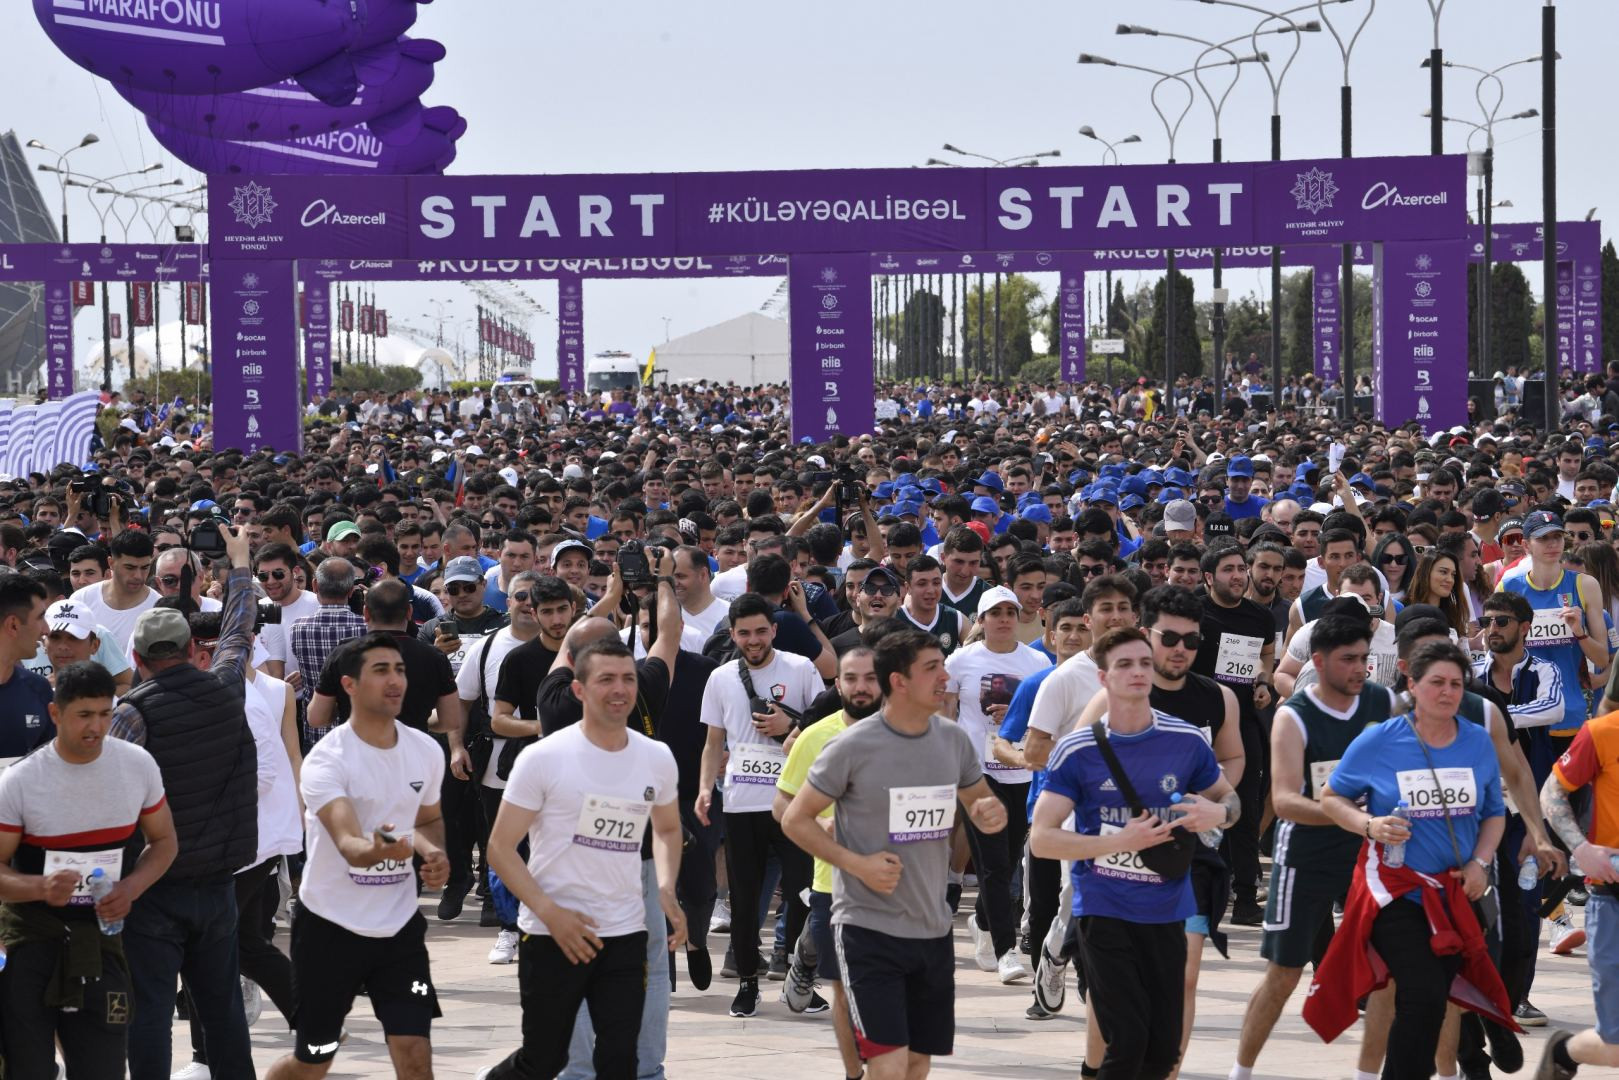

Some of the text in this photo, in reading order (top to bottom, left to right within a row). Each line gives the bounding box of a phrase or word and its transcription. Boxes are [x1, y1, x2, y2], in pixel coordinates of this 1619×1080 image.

[998, 183, 1243, 230] START
[1392, 192, 1447, 206] Azercell
[419, 194, 665, 239] START
[708, 194, 966, 224] #KÜLƏYƏQALİBGƏL
[331, 212, 386, 225] Azercell
[1318, 220, 1345, 228] ƏLİYEV
[1529, 623, 1567, 638] 12101
[1225, 637, 1240, 645] 2169
[1225, 661, 1254, 676] 2169
[742, 759, 782, 775] 5632
[1408, 787, 1470, 807] 10586
[905, 808, 945, 828] 9717
[594, 817, 635, 839] 9712
[894, 832, 921, 841] KÜLƏYƏ
[1106, 851, 1145, 869] 320
[1097, 867, 1126, 878] KÜLƏYƏ
[1126, 872, 1148, 881] QALİB
